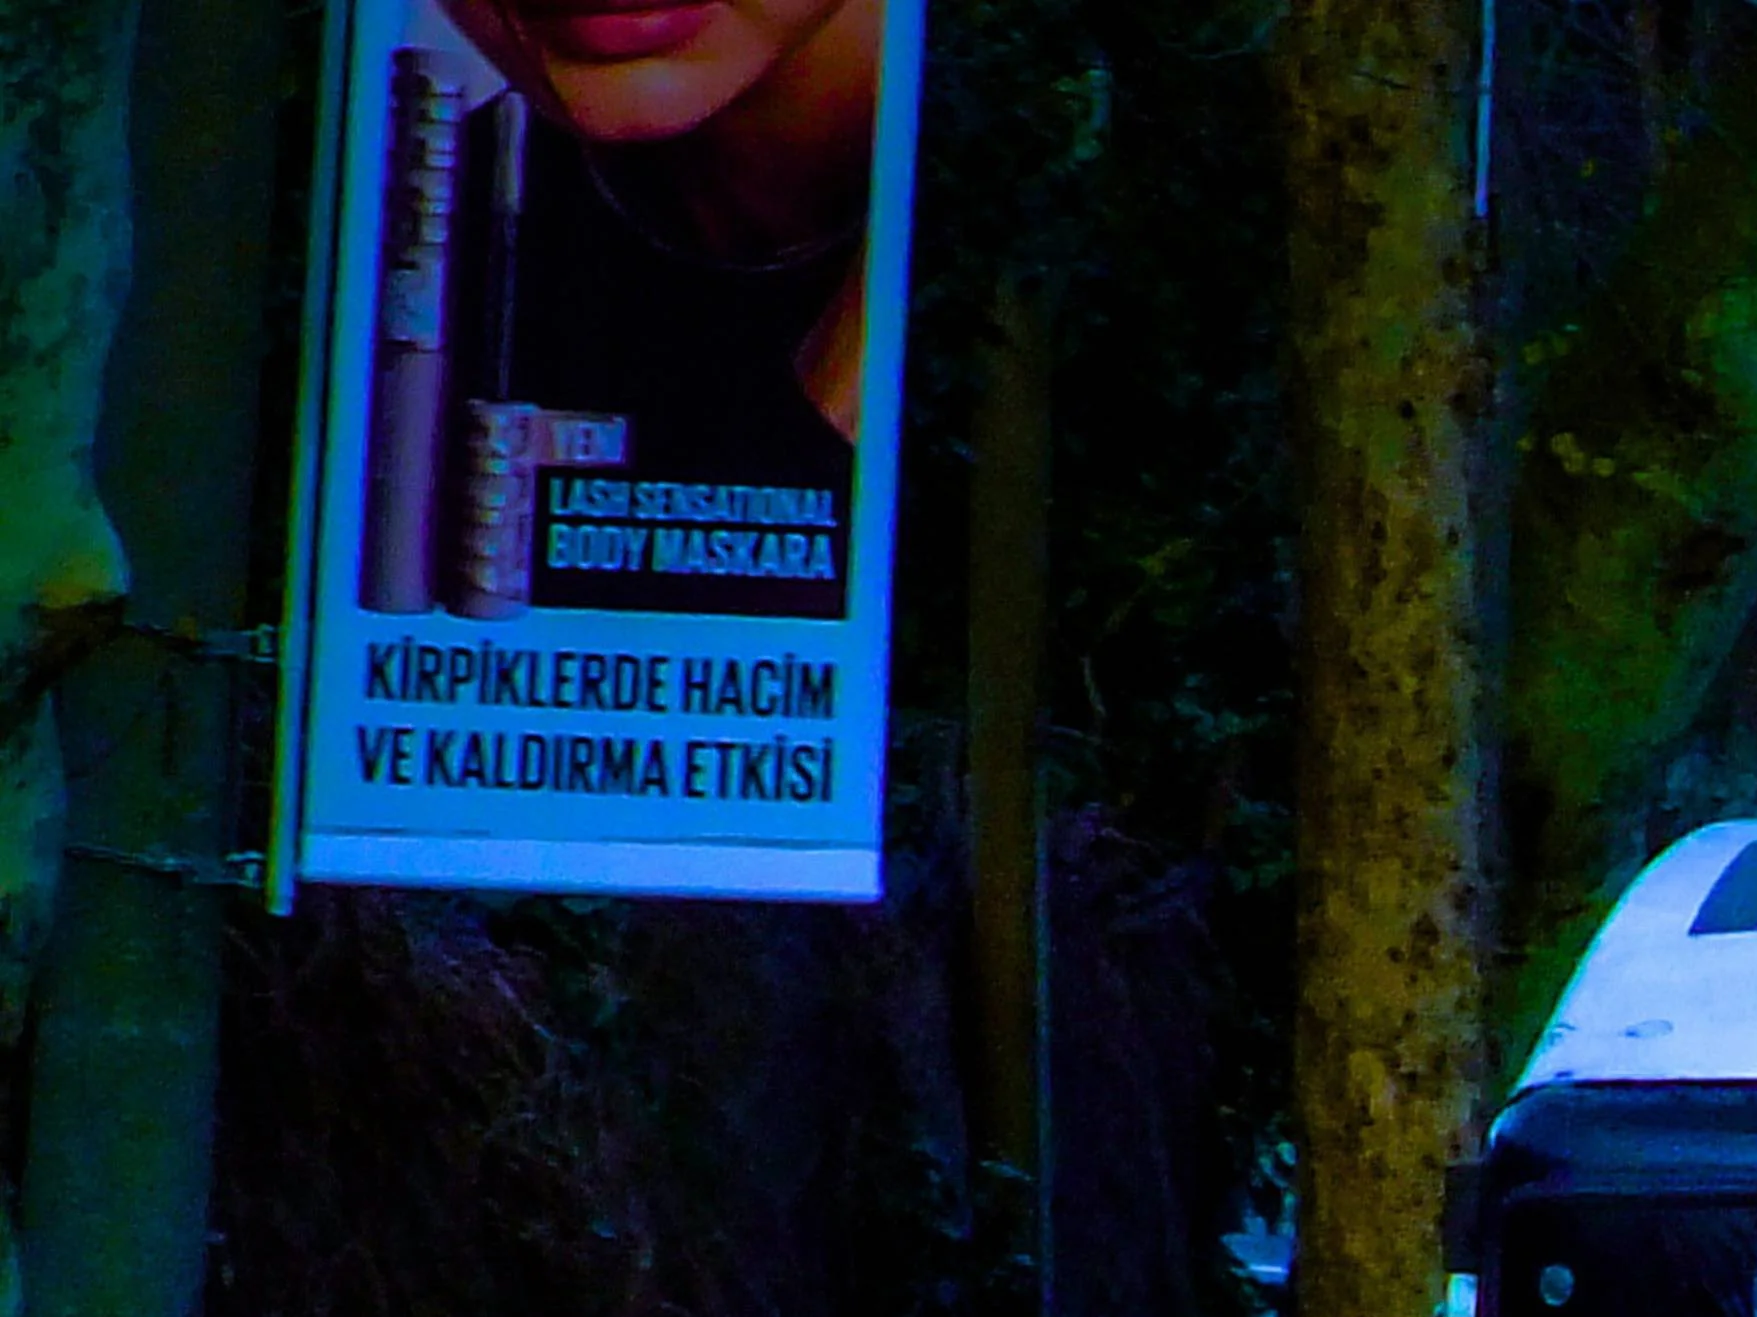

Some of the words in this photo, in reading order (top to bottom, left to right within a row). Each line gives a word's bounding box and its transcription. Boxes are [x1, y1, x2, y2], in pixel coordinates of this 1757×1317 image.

[549, 477, 630, 518] LASH
[547, 524, 648, 572] BODY
[651, 529, 837, 580] MASKARA
[365, 635, 670, 713] KİRPİKLERDE
[681, 652, 836, 720] HACİM
[356, 725, 415, 787] VE
[426, 728, 671, 797] KALDIRMA
[684, 734, 834, 804] ETKİSİ
